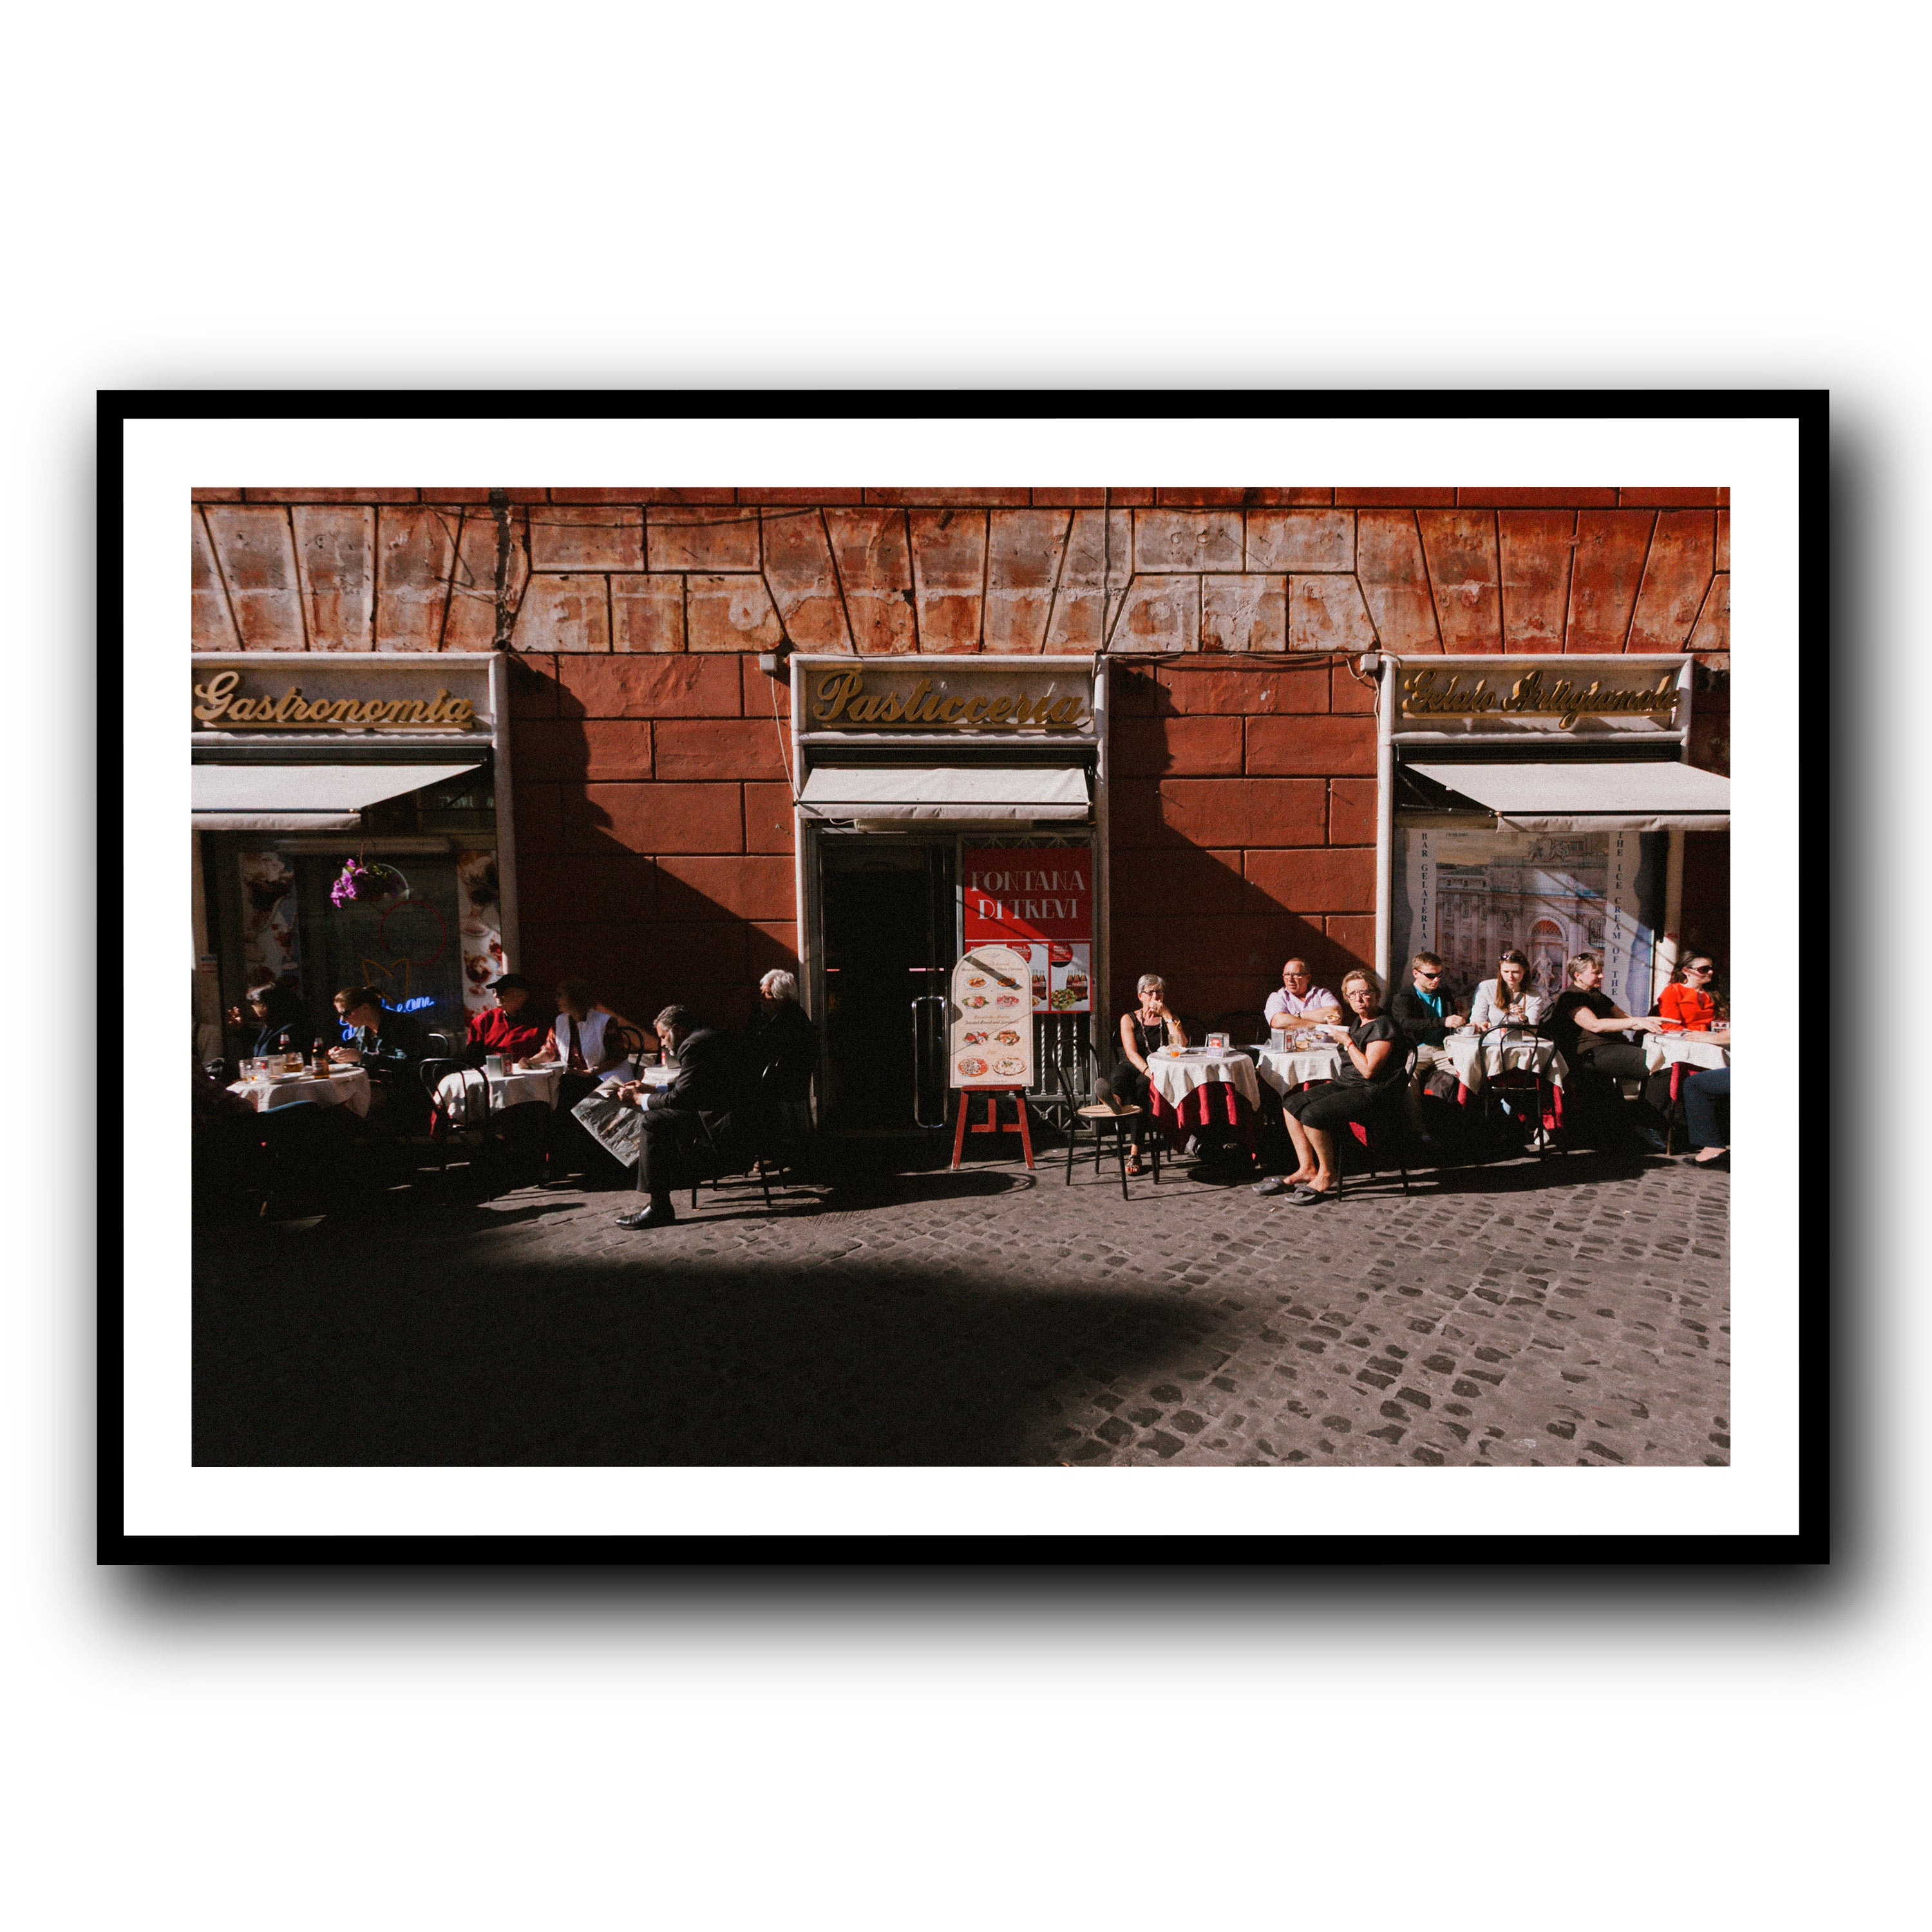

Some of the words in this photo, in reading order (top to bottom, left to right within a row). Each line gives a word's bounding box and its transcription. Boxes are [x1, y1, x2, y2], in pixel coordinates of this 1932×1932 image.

[194, 671, 477, 722] Gastronomia
[813, 668, 1085, 723] Pasticceria
[1401, 668, 1496, 713] Gelato
[1500, 670, 1680, 729] Artigianale
[971, 871, 1086, 891] FONTANA
[978, 899, 1004, 920] DI
[1009, 898, 1078, 919] TREVI
[1613, 897, 1621, 940] CREAM
[1613, 947, 1620, 963] OF
